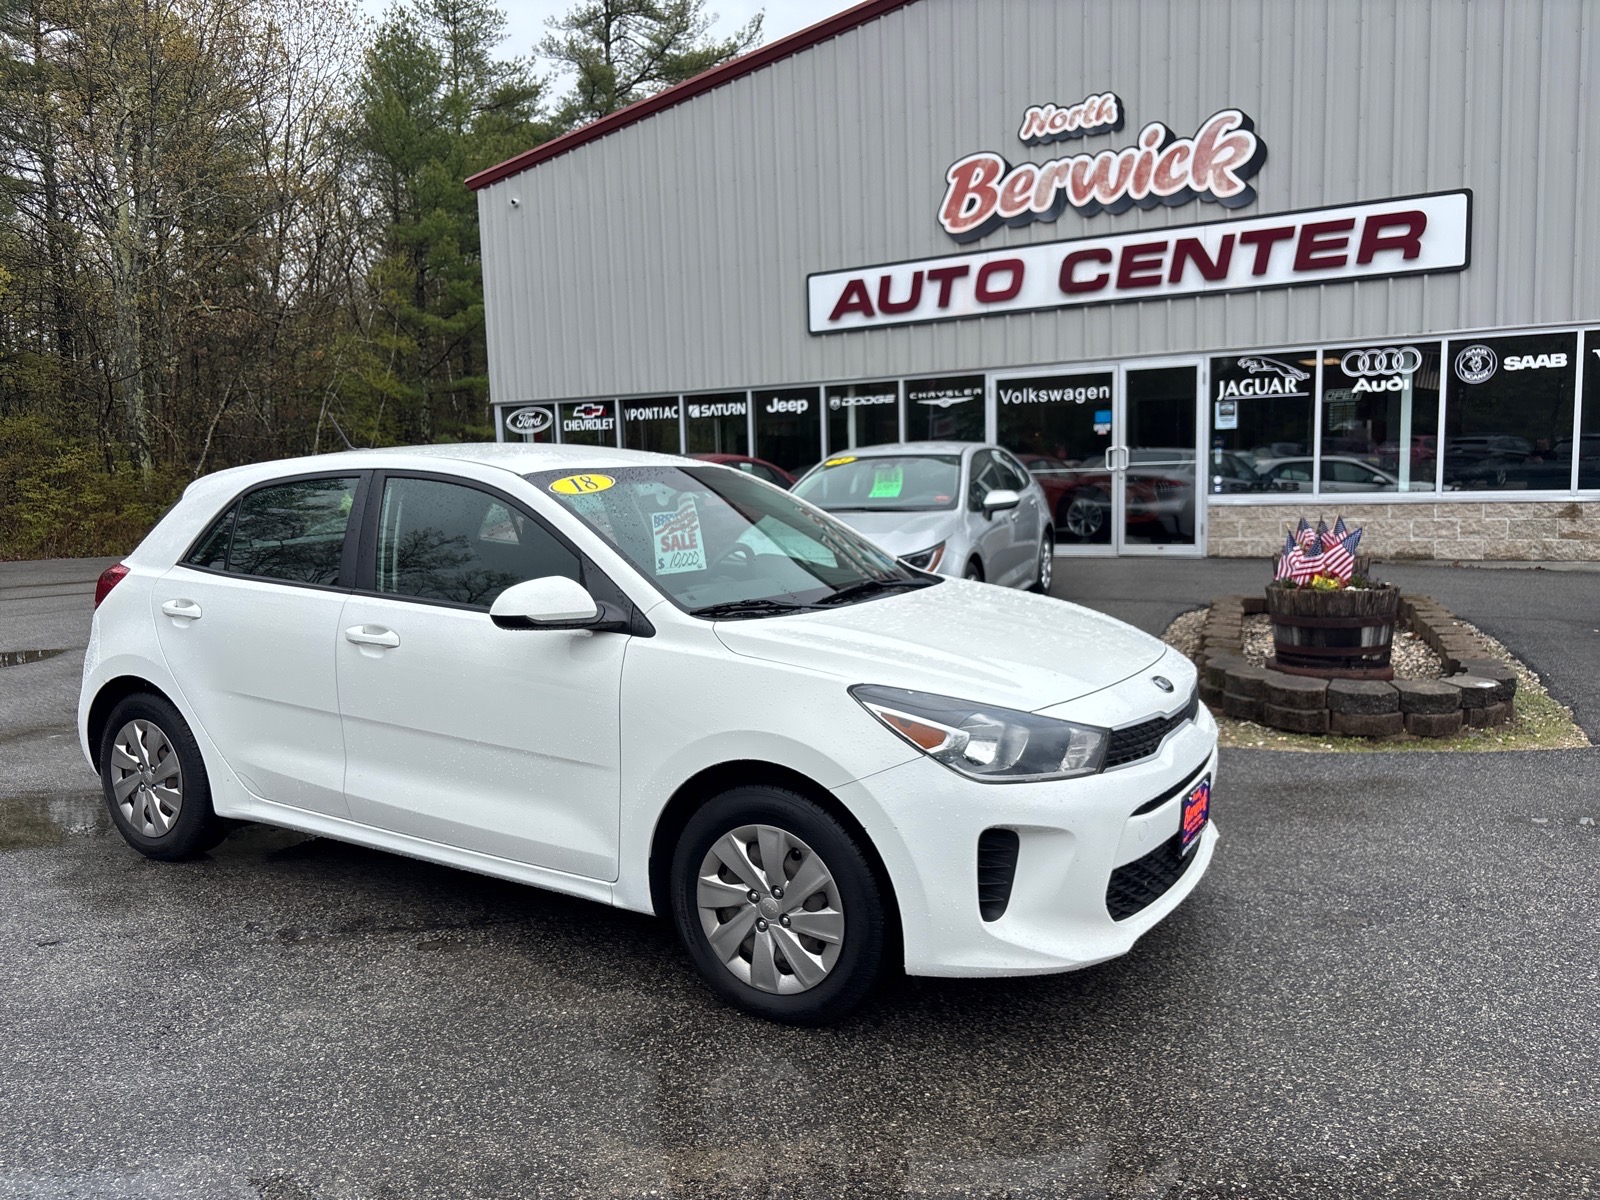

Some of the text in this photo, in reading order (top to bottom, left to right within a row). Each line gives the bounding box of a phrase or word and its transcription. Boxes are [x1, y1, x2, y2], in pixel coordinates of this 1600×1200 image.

[1021, 92, 1119, 141] North
[938, 108, 1258, 233] Berwick
[828, 210, 1428, 321] AUTO CENTER
[1503, 353, 1568, 371] SAAB
[909, 387, 982, 399] CHRYSLER
[1217, 377, 1298, 401] JAGUAR
[1351, 375, 1410, 393] Audi
[841, 394, 896, 407] DODGE
[999, 386, 1110, 404] Volkswagen
[630, 406, 679, 421] PONTIAC
[701, 402, 746, 417] SATURN
[766, 398, 809, 414] Jeep
[516, 412, 543, 428] Ford
[563, 418, 614, 432] CHEVROLET
[569, 475, 599, 493] 18
[661, 533, 698, 553] SALE
